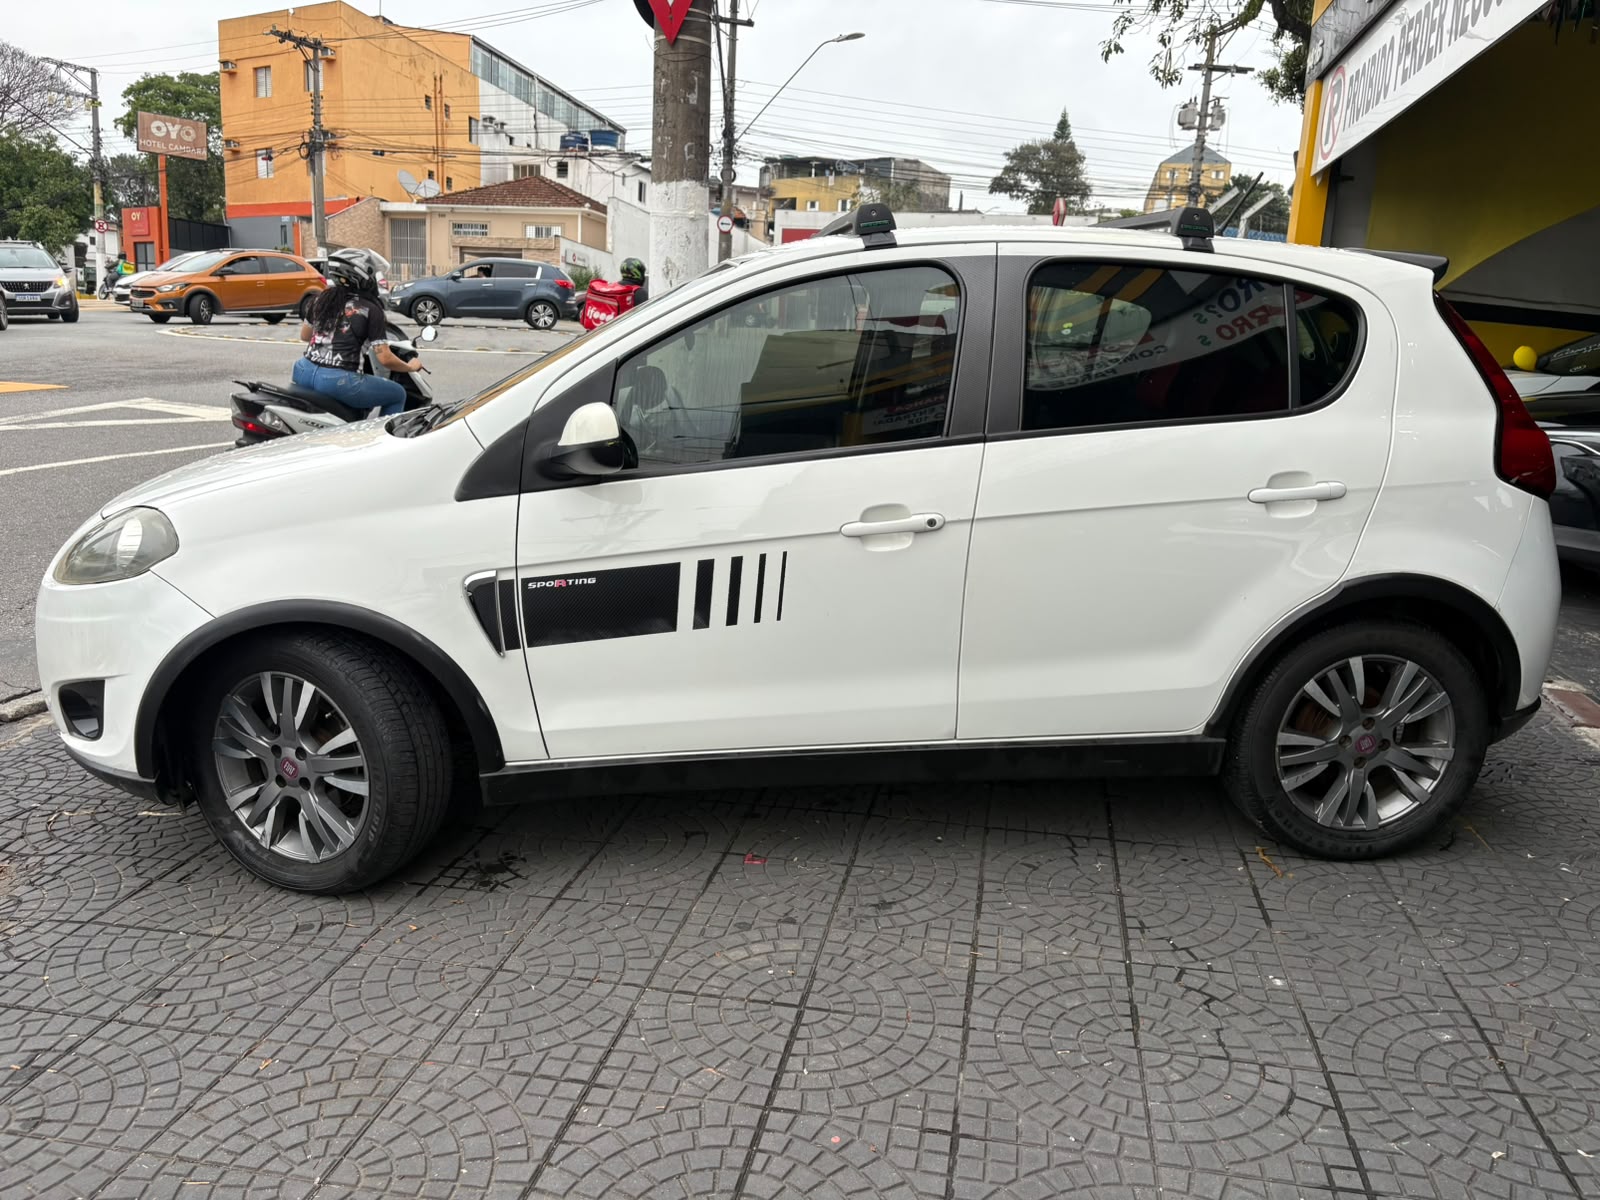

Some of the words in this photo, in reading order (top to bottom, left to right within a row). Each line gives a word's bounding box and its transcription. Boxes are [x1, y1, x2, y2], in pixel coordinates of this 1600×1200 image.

[1343, 35, 1395, 132] PROIBIDO
[1394, 0, 1448, 92] PERDER
[150, 120, 197, 142] OYO
[140, 138, 167, 149] HOTEL
[527, 577, 597, 590] SPORTING
[283, 760, 296, 776] FIAT
